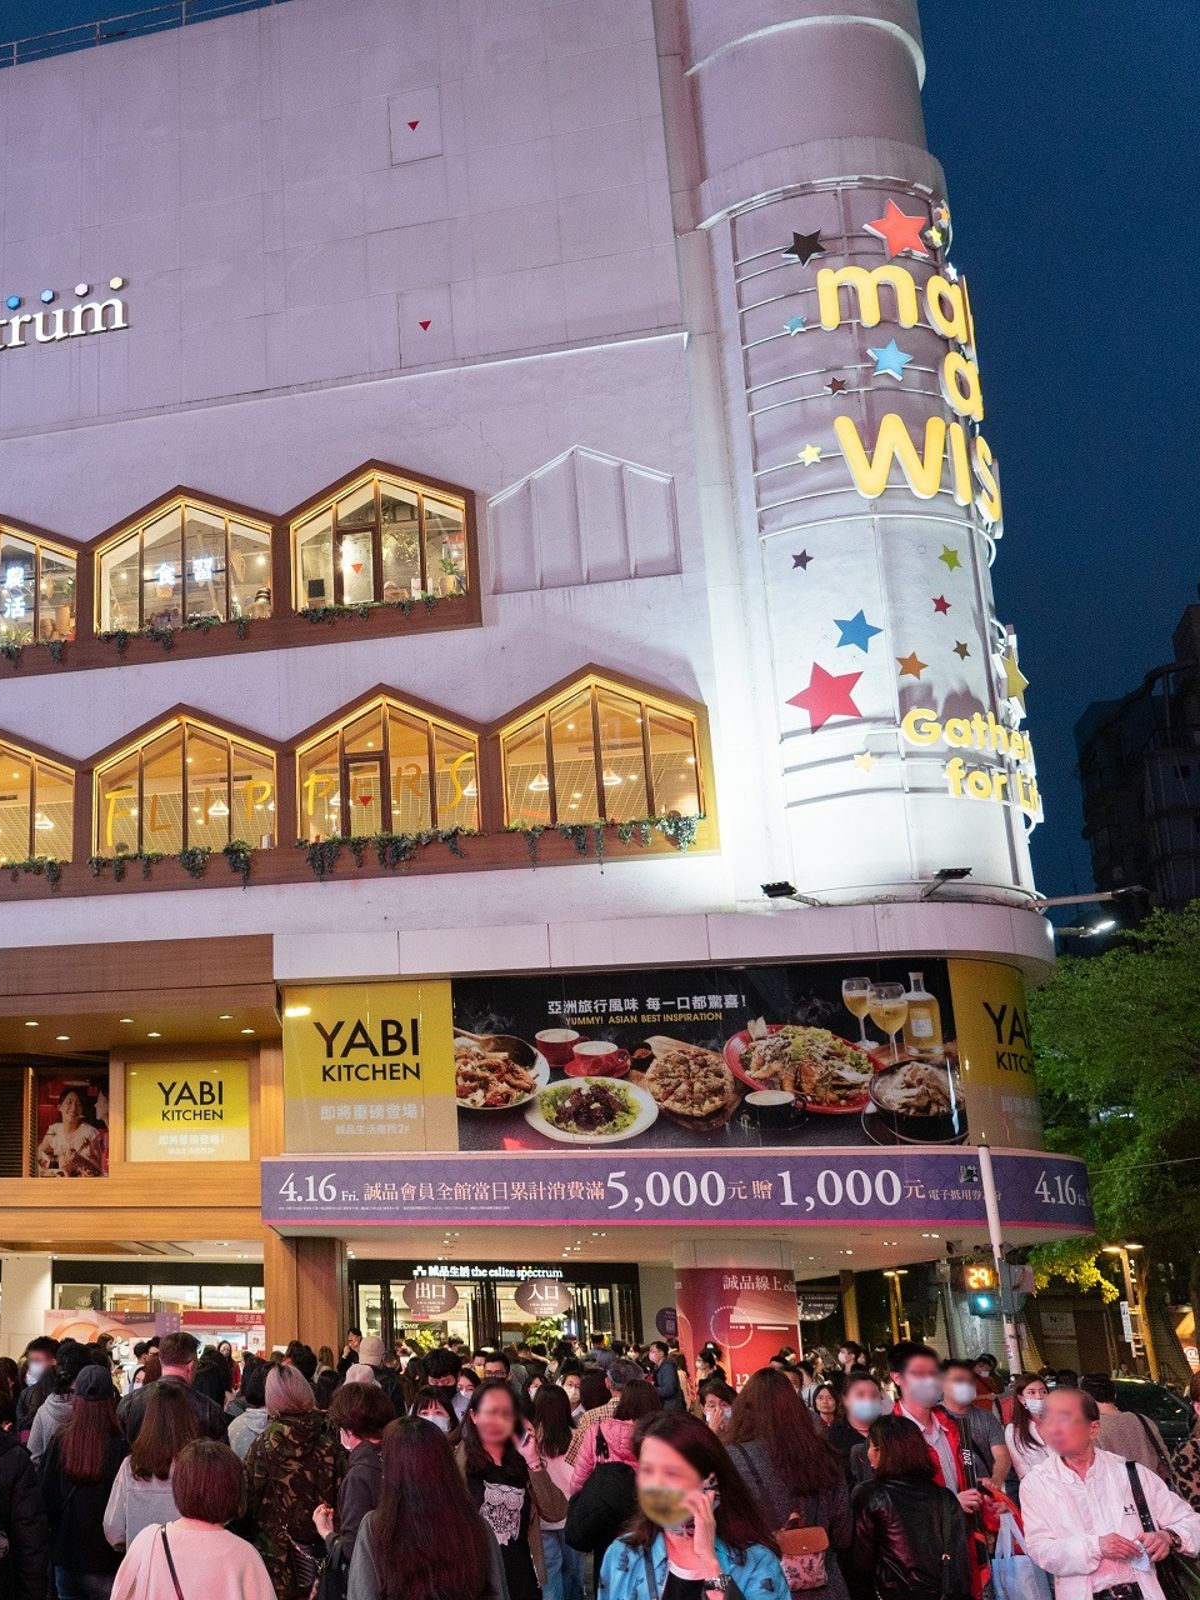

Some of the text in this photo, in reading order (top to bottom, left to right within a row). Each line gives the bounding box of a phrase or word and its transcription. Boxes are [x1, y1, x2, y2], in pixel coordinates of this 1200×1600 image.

[817, 265, 977, 360] ma
[940, 352, 984, 422] a
[833, 413, 1002, 527] WIS
[946, 757, 1008, 801] for
[548, 998, 639, 1015] 亞洲旅行風味
[566, 1012, 723, 1026] YUMMY! ASIAN BEST INSPIRATION
[313, 1018, 420, 1058] YABI
[983, 1002, 1031, 1051] YA
[322, 1062, 421, 1082] KITCHEN
[157, 1081, 224, 1106] YABI
[161, 1109, 224, 1121] KITCHEN
[278, 1172, 337, 1202] 4.16
[341, 1190, 359, 1201] Fri.
[1034, 1170, 1076, 1206] 4.16
[471, 1266, 487, 1277] the
[488, 1265, 515, 1278] eslite
[516, 1268, 563, 1280] spectrum
[723, 1275, 782, 1291] 誠品線上
[415, 1283, 446, 1299] 出口
[528, 1284, 559, 1301] 入口
